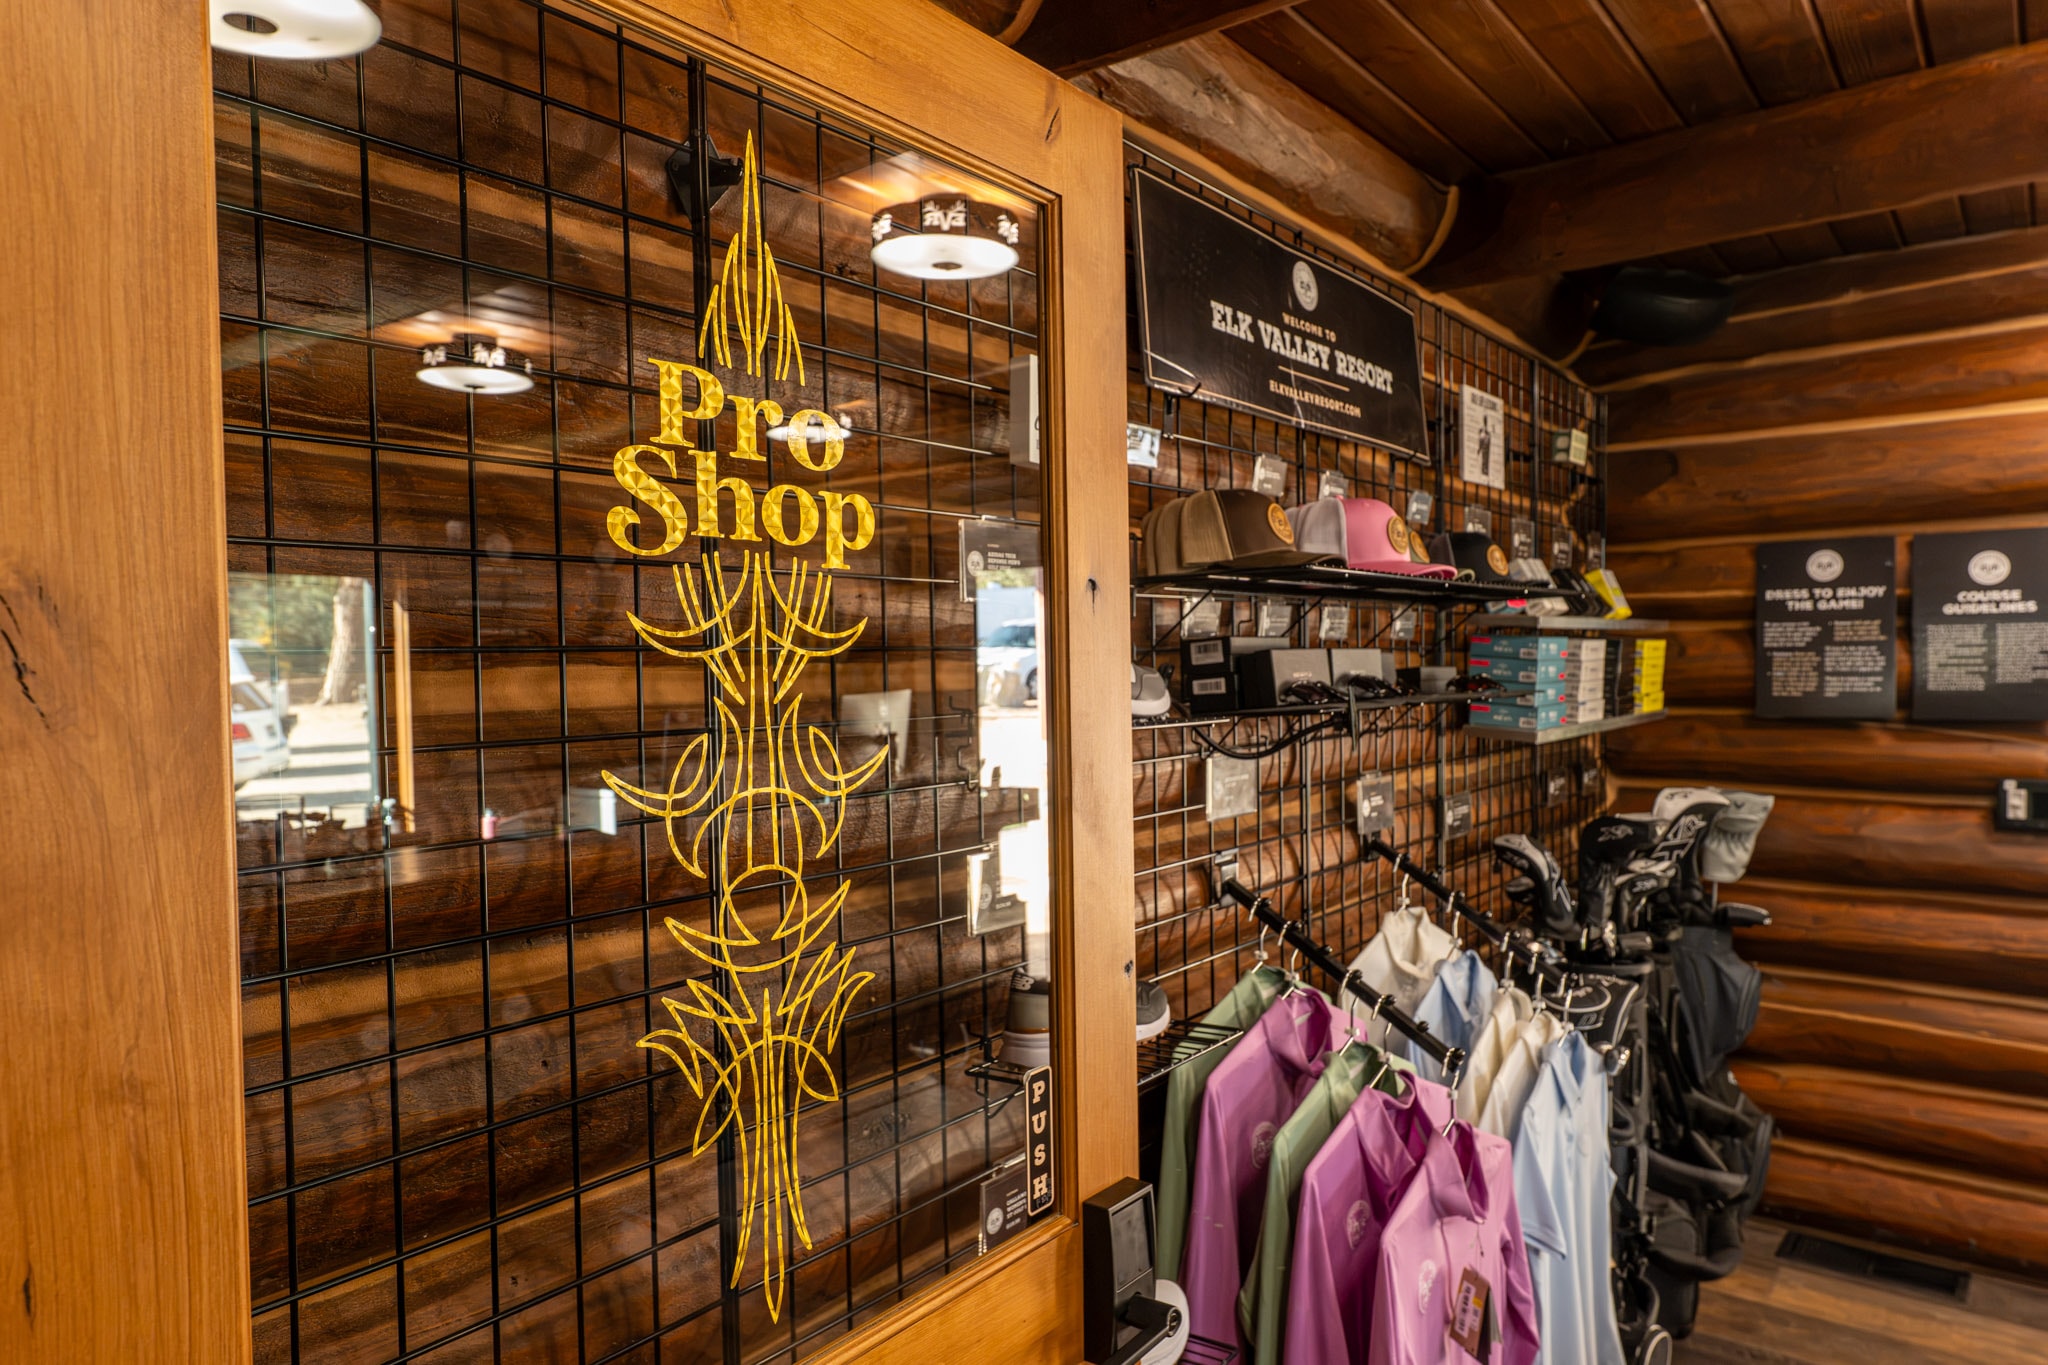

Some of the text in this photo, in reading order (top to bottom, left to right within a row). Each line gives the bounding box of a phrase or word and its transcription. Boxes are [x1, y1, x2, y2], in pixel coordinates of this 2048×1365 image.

[1282, 312, 1337, 343] WELCOME TO
[1210, 300, 1393, 394] ELK VALLEY RESORT
[647, 357, 845, 471] Pro
[1269, 379, 1361, 418] ELKVALLEYRESORT.COM
[606, 444, 876, 570] Shop
[1764, 585, 1887, 601] DRESS TO ENJOY
[1785, 600, 1814, 611] THE
[1942, 600, 2038, 615] GUIDELINES
[1957, 588, 2022, 603] COURSE
[1031, 1079, 1049, 1201] PUSH
